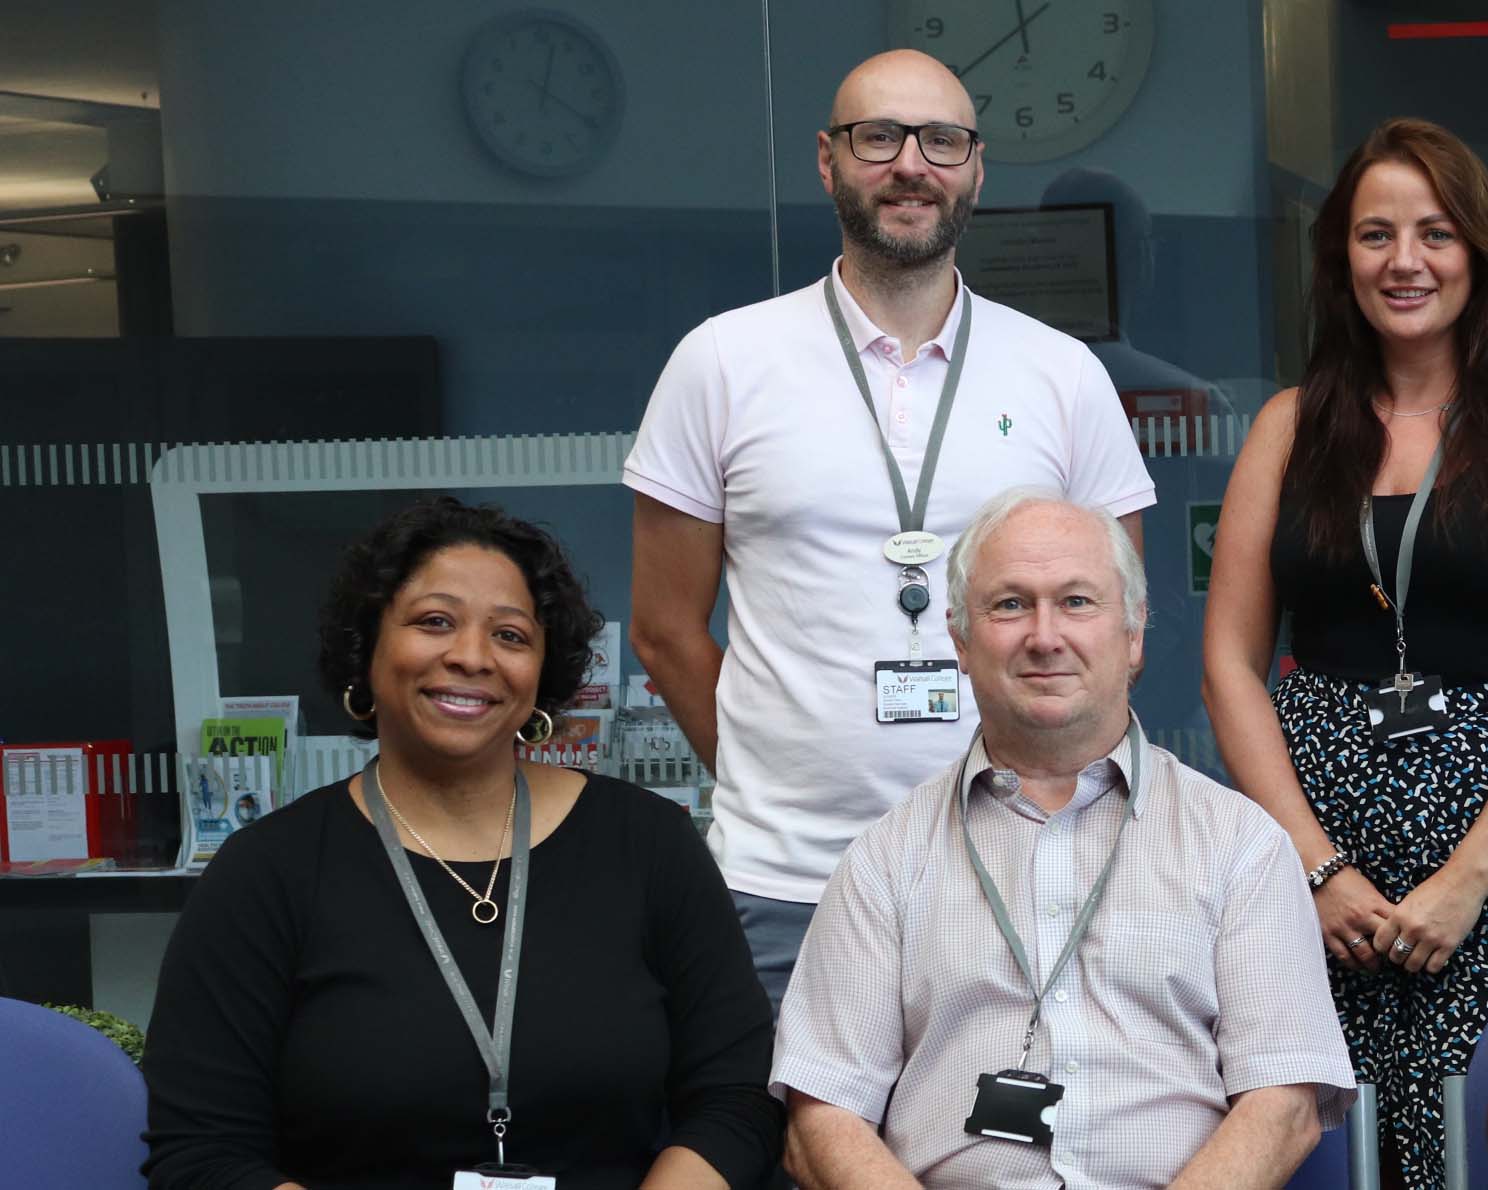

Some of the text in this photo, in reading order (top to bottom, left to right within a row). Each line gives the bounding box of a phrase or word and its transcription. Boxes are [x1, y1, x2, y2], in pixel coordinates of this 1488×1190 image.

[925, 17, 944, 38] 9
[1103, 13, 1119, 34] 3
[1087, 60, 1106, 81] 4
[1057, 93, 1075, 114] 5
[1015, 106, 1033, 128] 6
[883, 684, 916, 695] STAFF
[208, 735, 278, 758] ACTION
